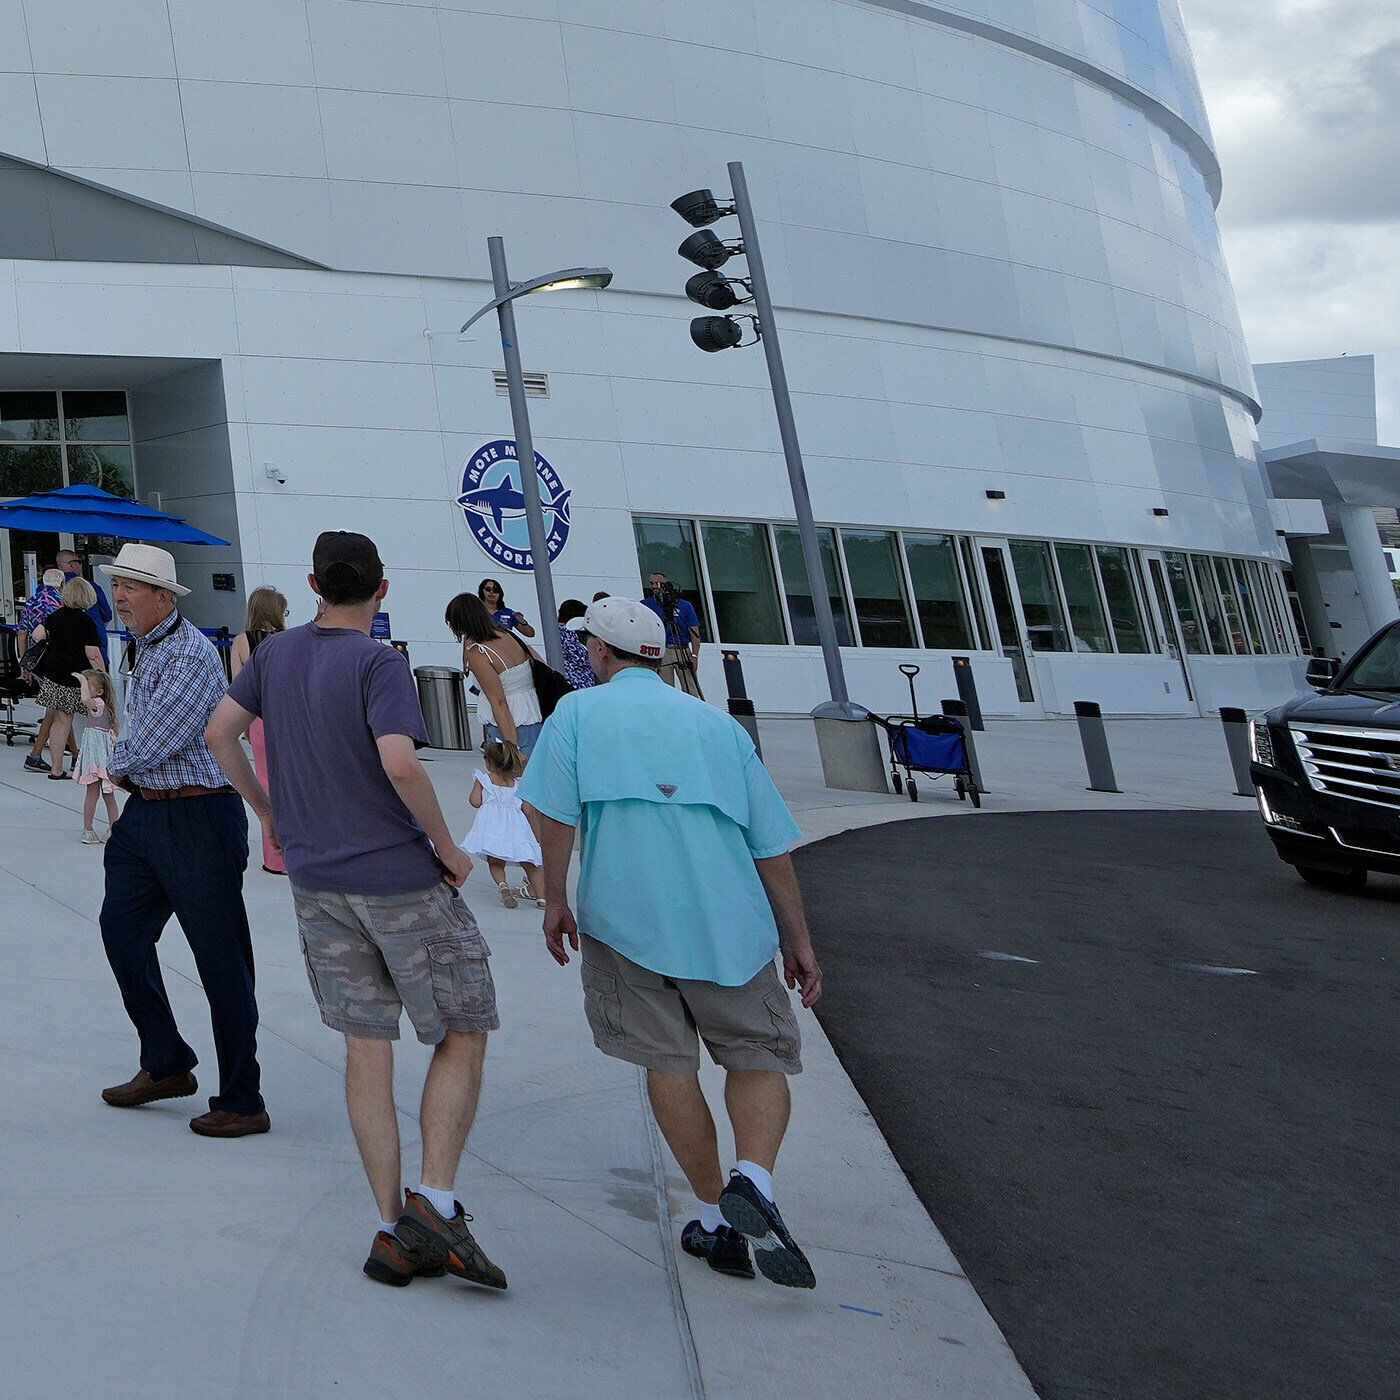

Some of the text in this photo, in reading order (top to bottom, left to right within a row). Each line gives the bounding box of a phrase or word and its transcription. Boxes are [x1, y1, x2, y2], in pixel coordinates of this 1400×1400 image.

[468, 445, 558, 490] MOTE MINE
[477, 526, 562, 566] LABORARY
